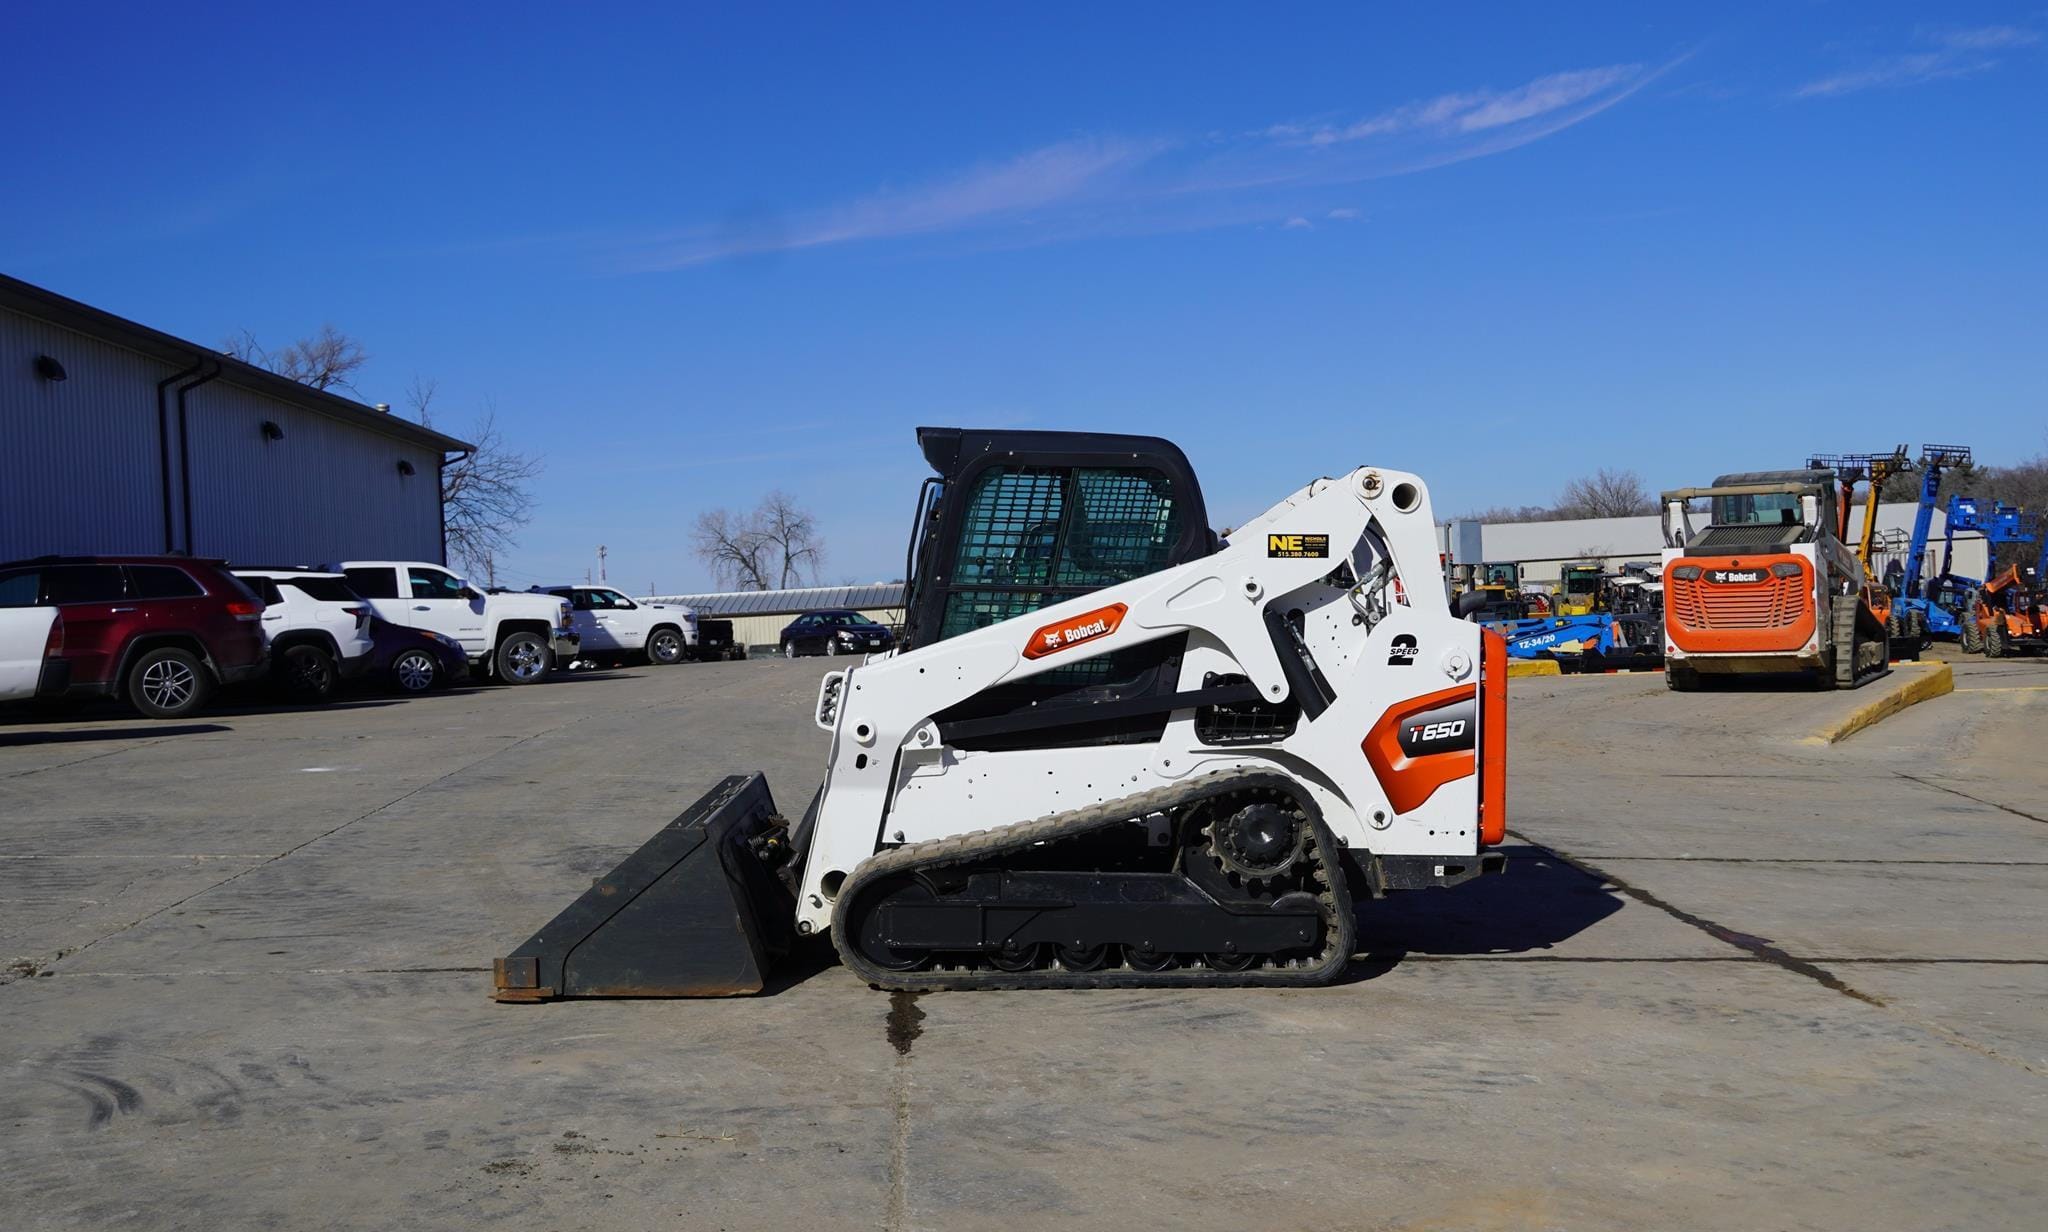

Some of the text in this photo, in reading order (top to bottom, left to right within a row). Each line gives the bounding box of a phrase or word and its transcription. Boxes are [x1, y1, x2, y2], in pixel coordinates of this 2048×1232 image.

[1270, 535, 1303, 551] NE
[1728, 572, 1757, 582] Bobcat
[1064, 619, 1106, 643] Bobcat
[1388, 633, 1417, 666] 2
[1519, 634, 1555, 649] TZ-34/20
[1409, 720, 1466, 743] T650
